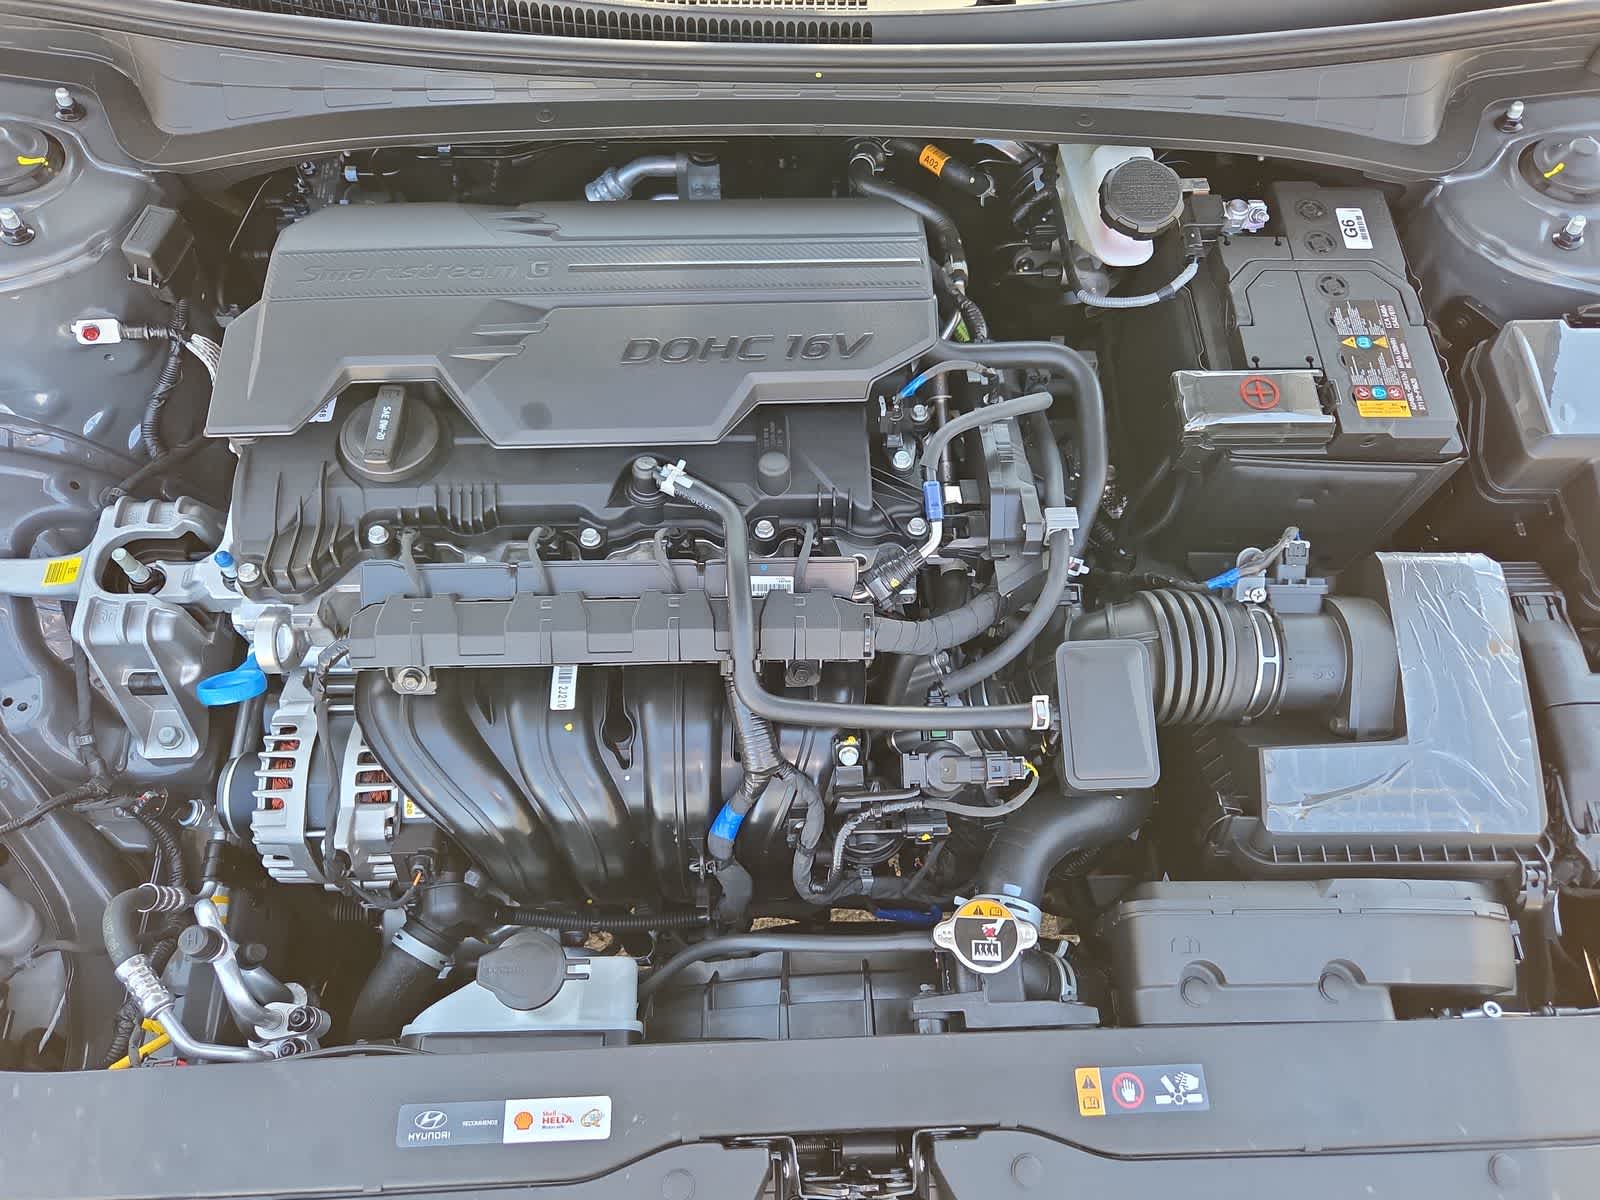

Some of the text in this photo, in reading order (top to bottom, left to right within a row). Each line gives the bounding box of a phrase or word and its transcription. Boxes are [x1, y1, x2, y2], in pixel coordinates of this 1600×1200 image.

[924, 156, 939, 170] A02
[1343, 219, 1358, 238] G6
[296, 260, 552, 284] Smartstream G
[619, 332, 874, 365] DOHC 16V
[381, 406, 392, 419] SAE
[542, 1115, 573, 1125] HELIX
[408, 1131, 450, 1142] HYUNDAI
